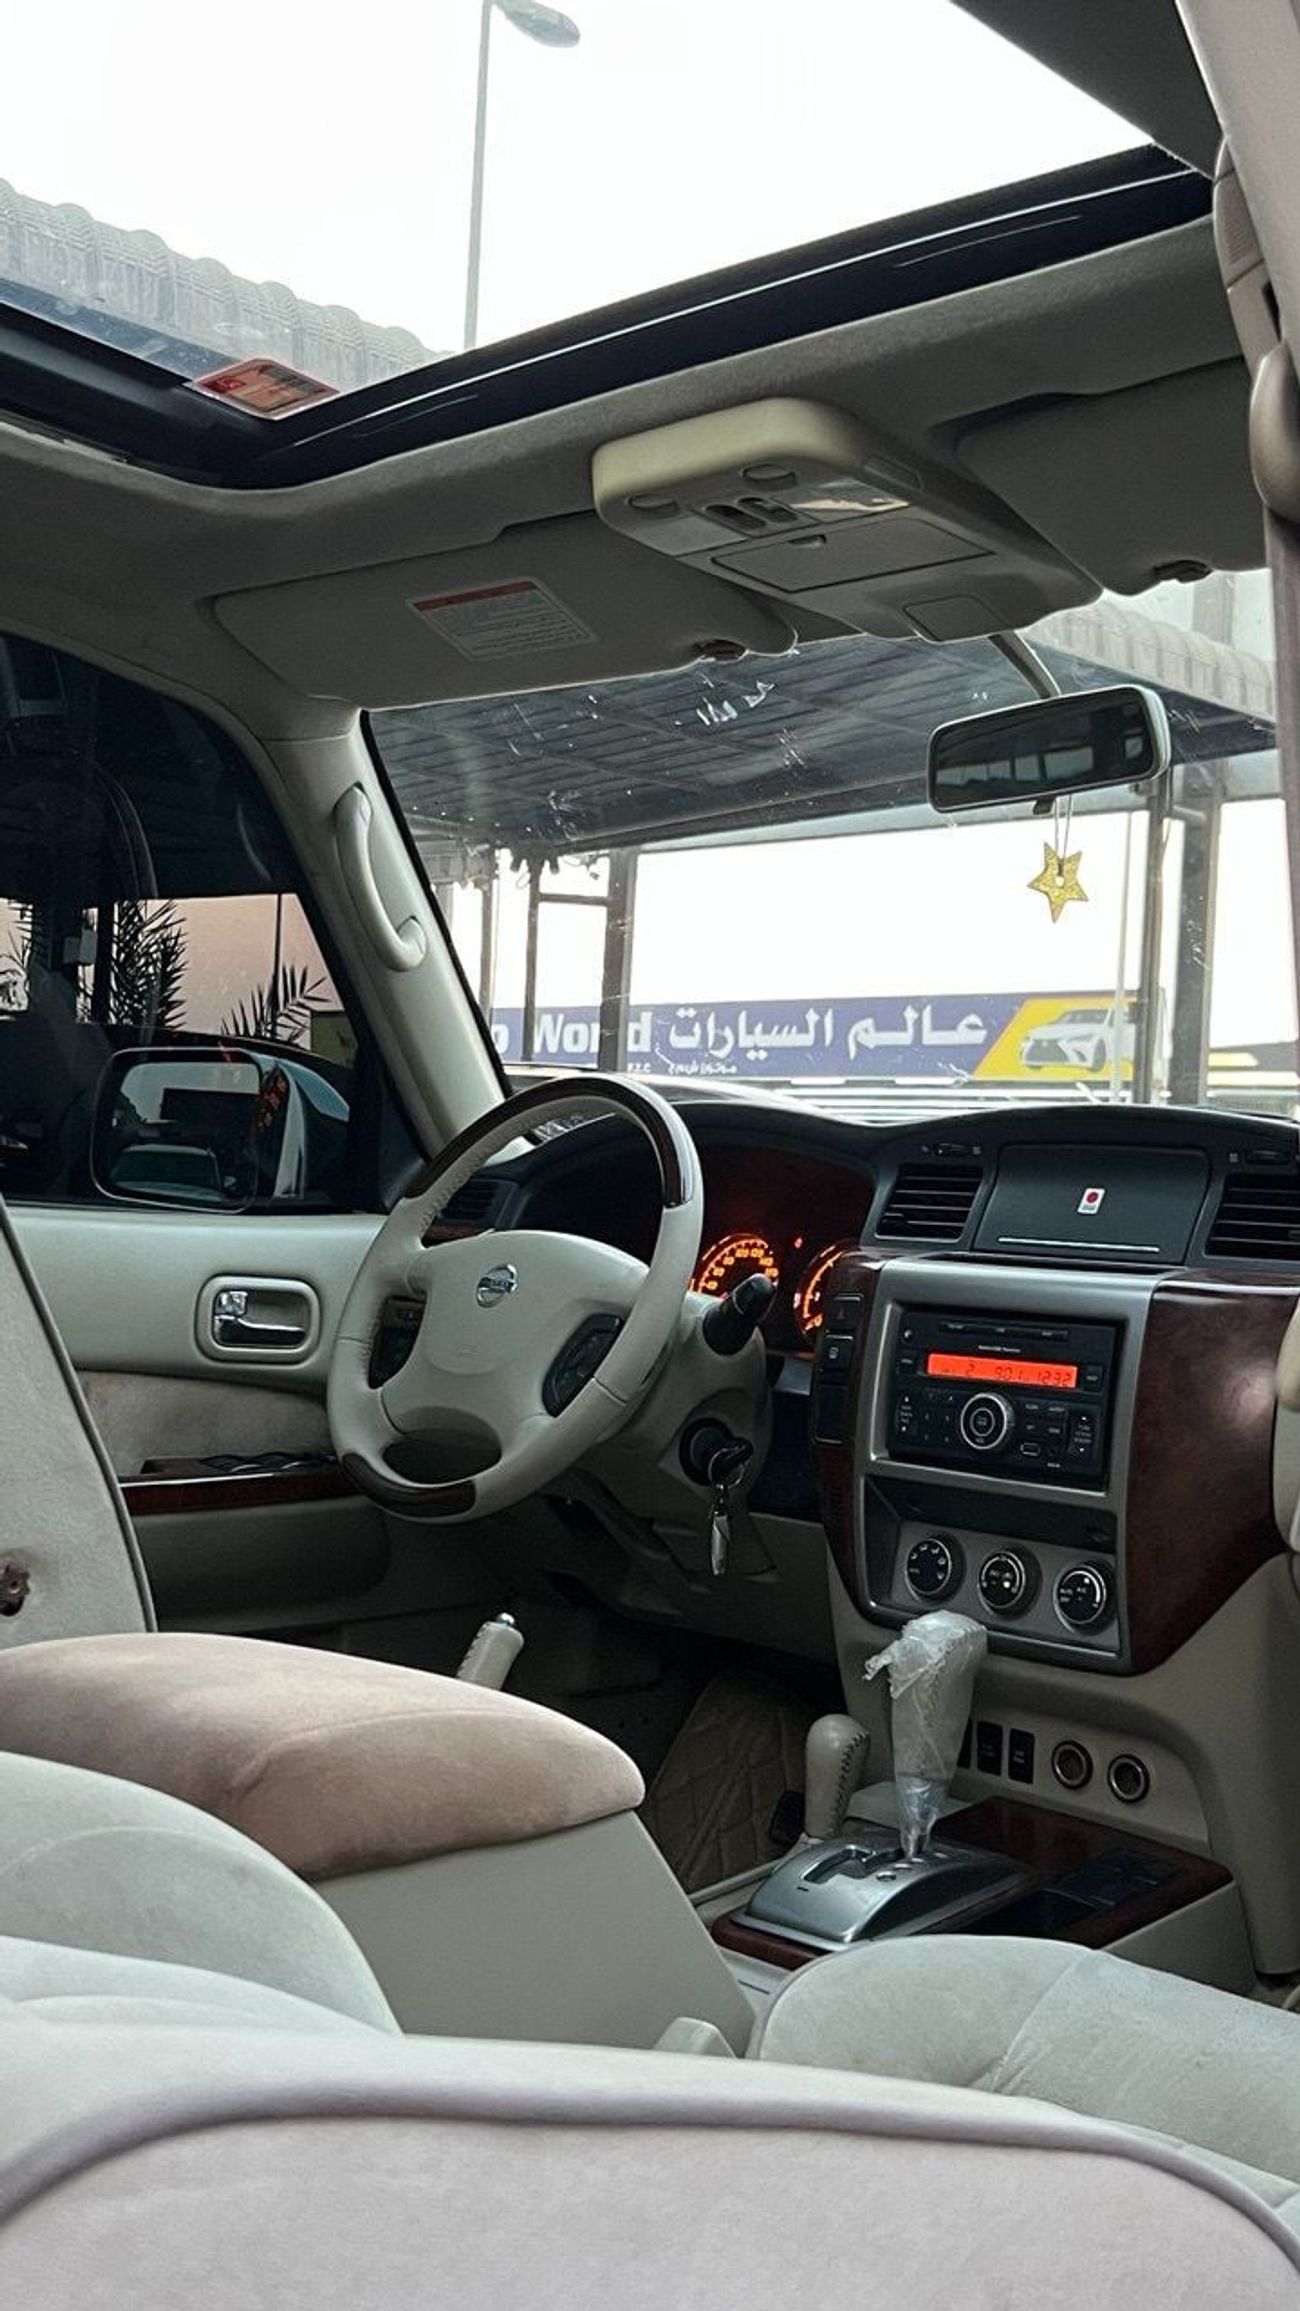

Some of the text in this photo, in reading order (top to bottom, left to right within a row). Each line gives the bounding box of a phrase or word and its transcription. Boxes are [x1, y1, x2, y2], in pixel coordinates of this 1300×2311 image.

[534, 1011, 652, 1053] Word
[669, 1004, 988, 1061] عالم السيارات
